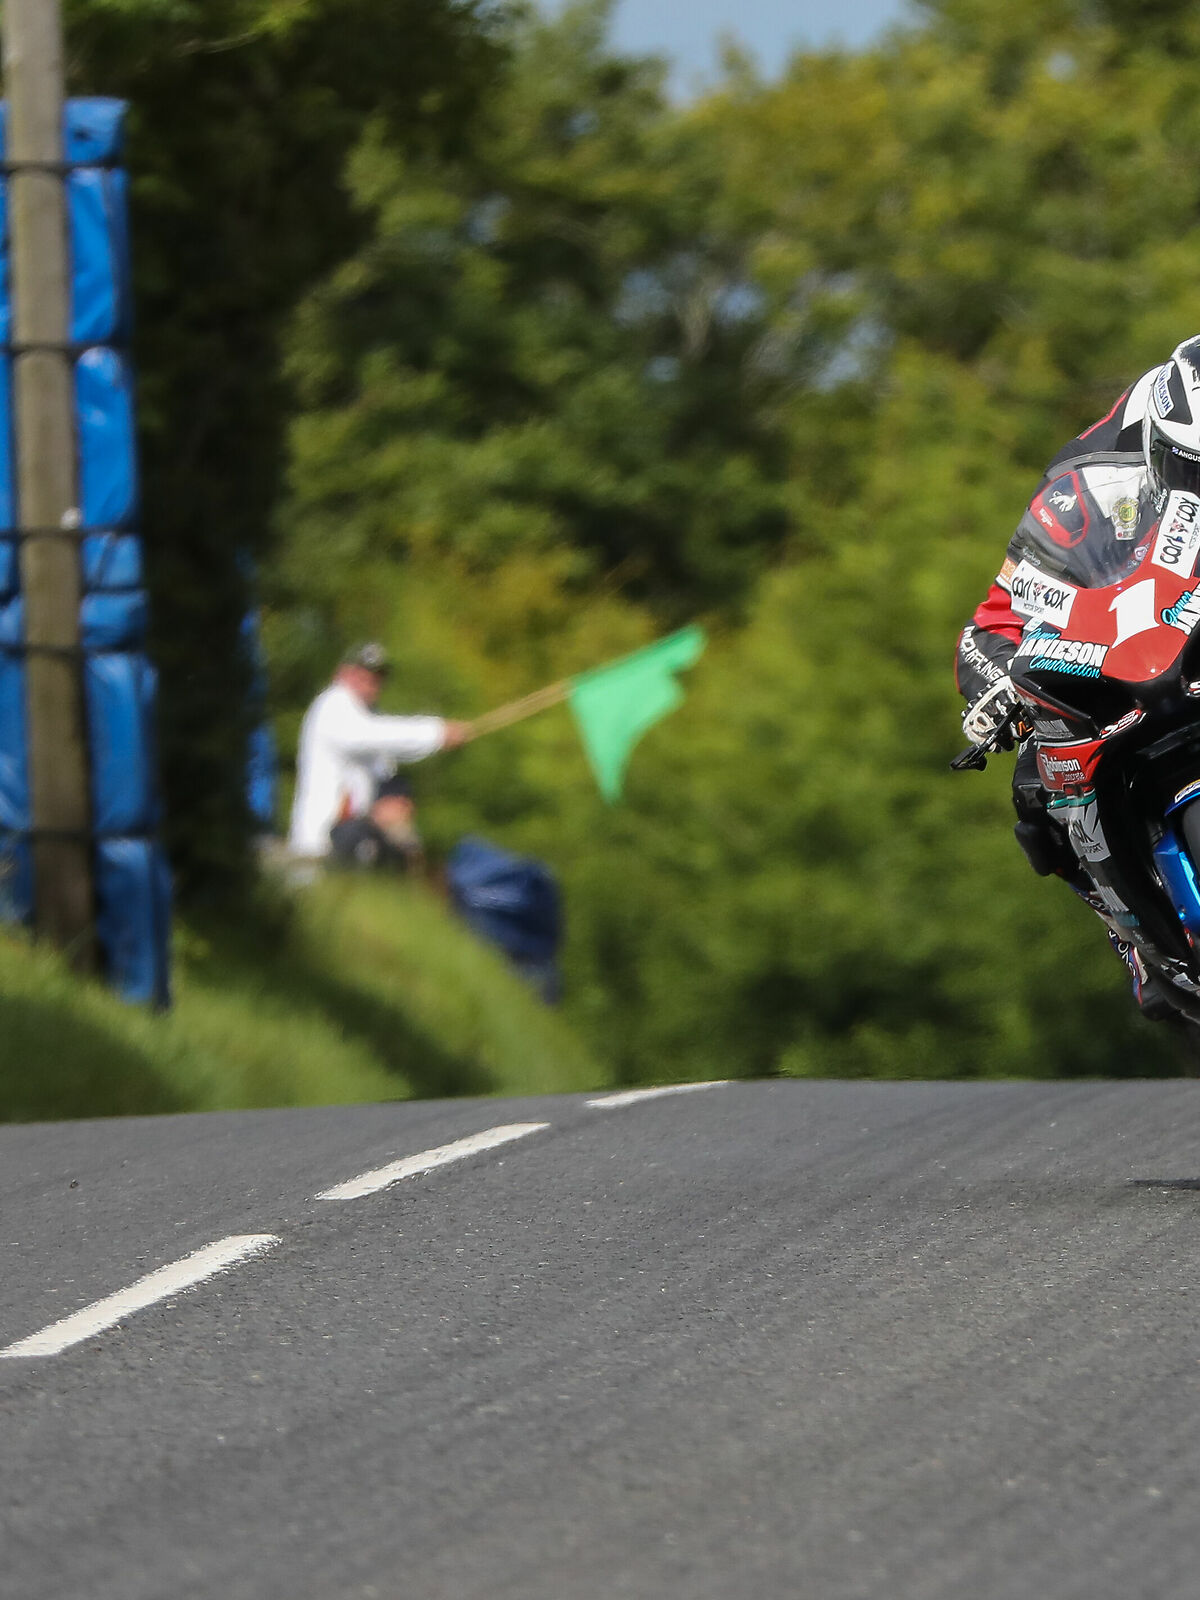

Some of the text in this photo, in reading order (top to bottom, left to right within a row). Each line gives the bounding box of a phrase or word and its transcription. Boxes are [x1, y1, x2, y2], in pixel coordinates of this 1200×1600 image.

[1108, 578, 1160, 648] 1
[1014, 638, 1110, 668] JAMIESON
[1029, 654, 1101, 679] Construction
[1040, 753, 1081, 781] Robinson
